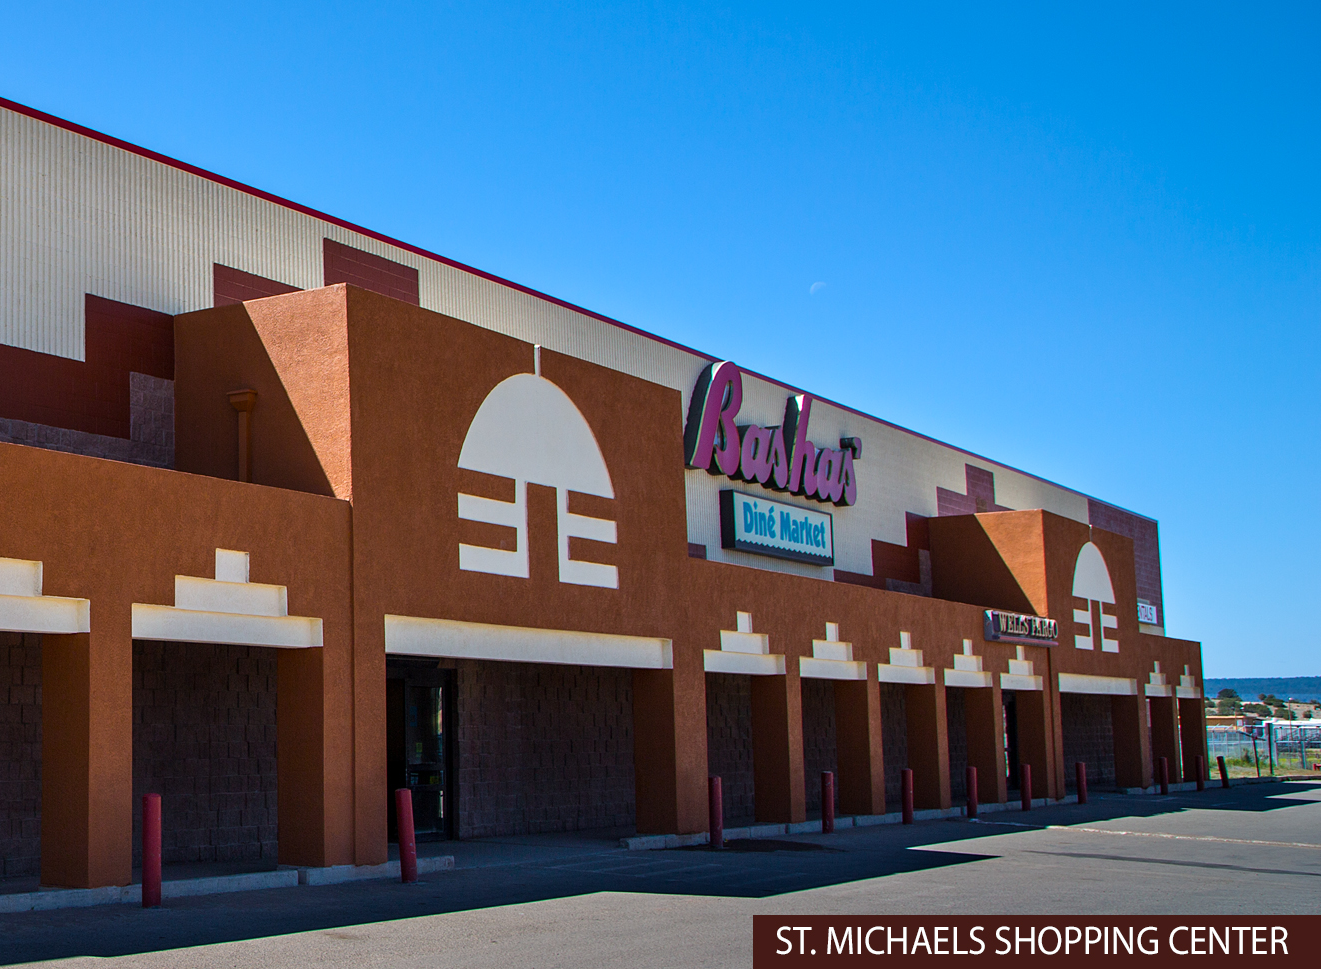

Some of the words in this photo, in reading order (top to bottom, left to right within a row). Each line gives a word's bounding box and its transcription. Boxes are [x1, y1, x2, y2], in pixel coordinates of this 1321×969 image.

[743, 501, 776, 539] Diné
[780, 511, 826, 549] Market
[999, 613, 1029, 634] WELLS
[1031, 616, 1058, 638] FARGO
